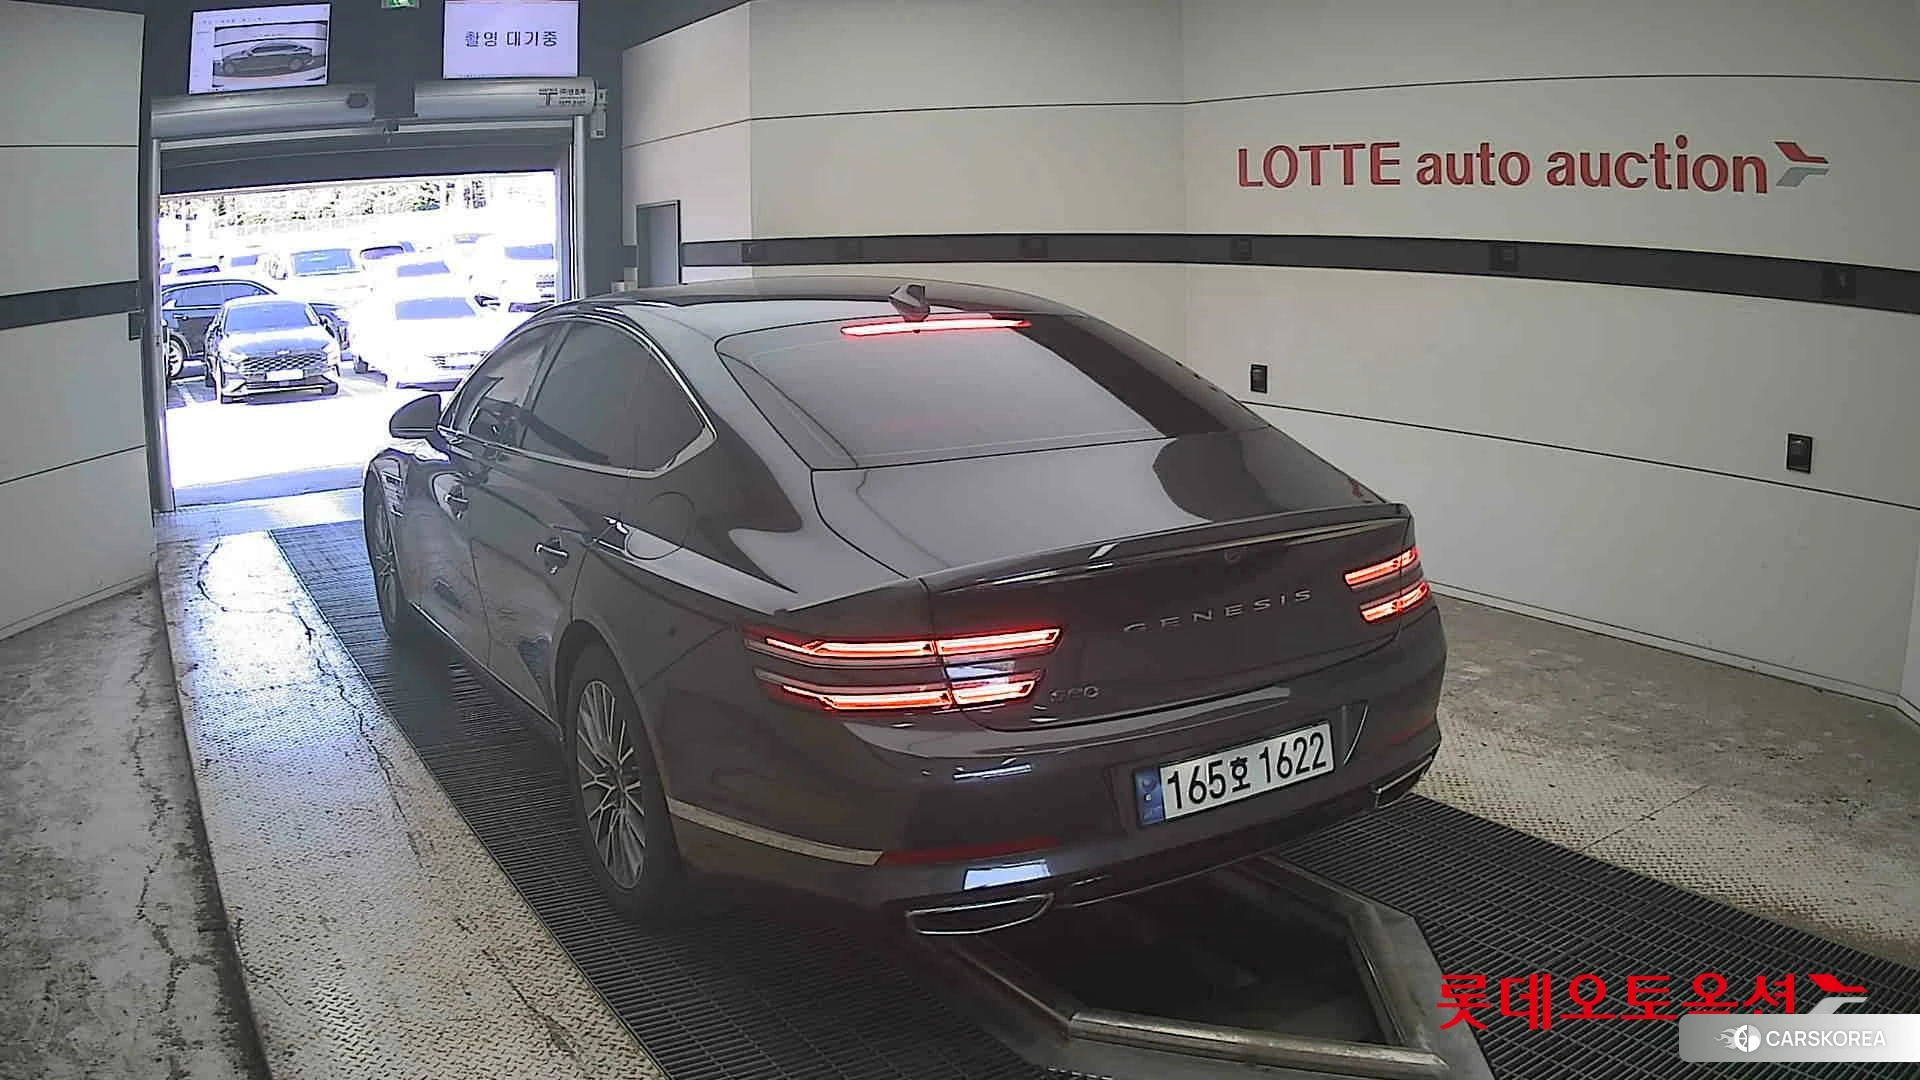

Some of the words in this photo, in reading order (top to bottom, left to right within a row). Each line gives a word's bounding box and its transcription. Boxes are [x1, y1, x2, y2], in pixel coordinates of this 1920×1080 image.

[506, 31, 558, 47] 대기중
[1238, 142, 1400, 188] LOTTE
[1416, 142, 1530, 186] auto
[1546, 134, 1768, 193] auction
[1123, 588, 1312, 632] GENESIS
[1167, 756, 1251, 809] 165호
[1259, 732, 1327, 783] 1622
